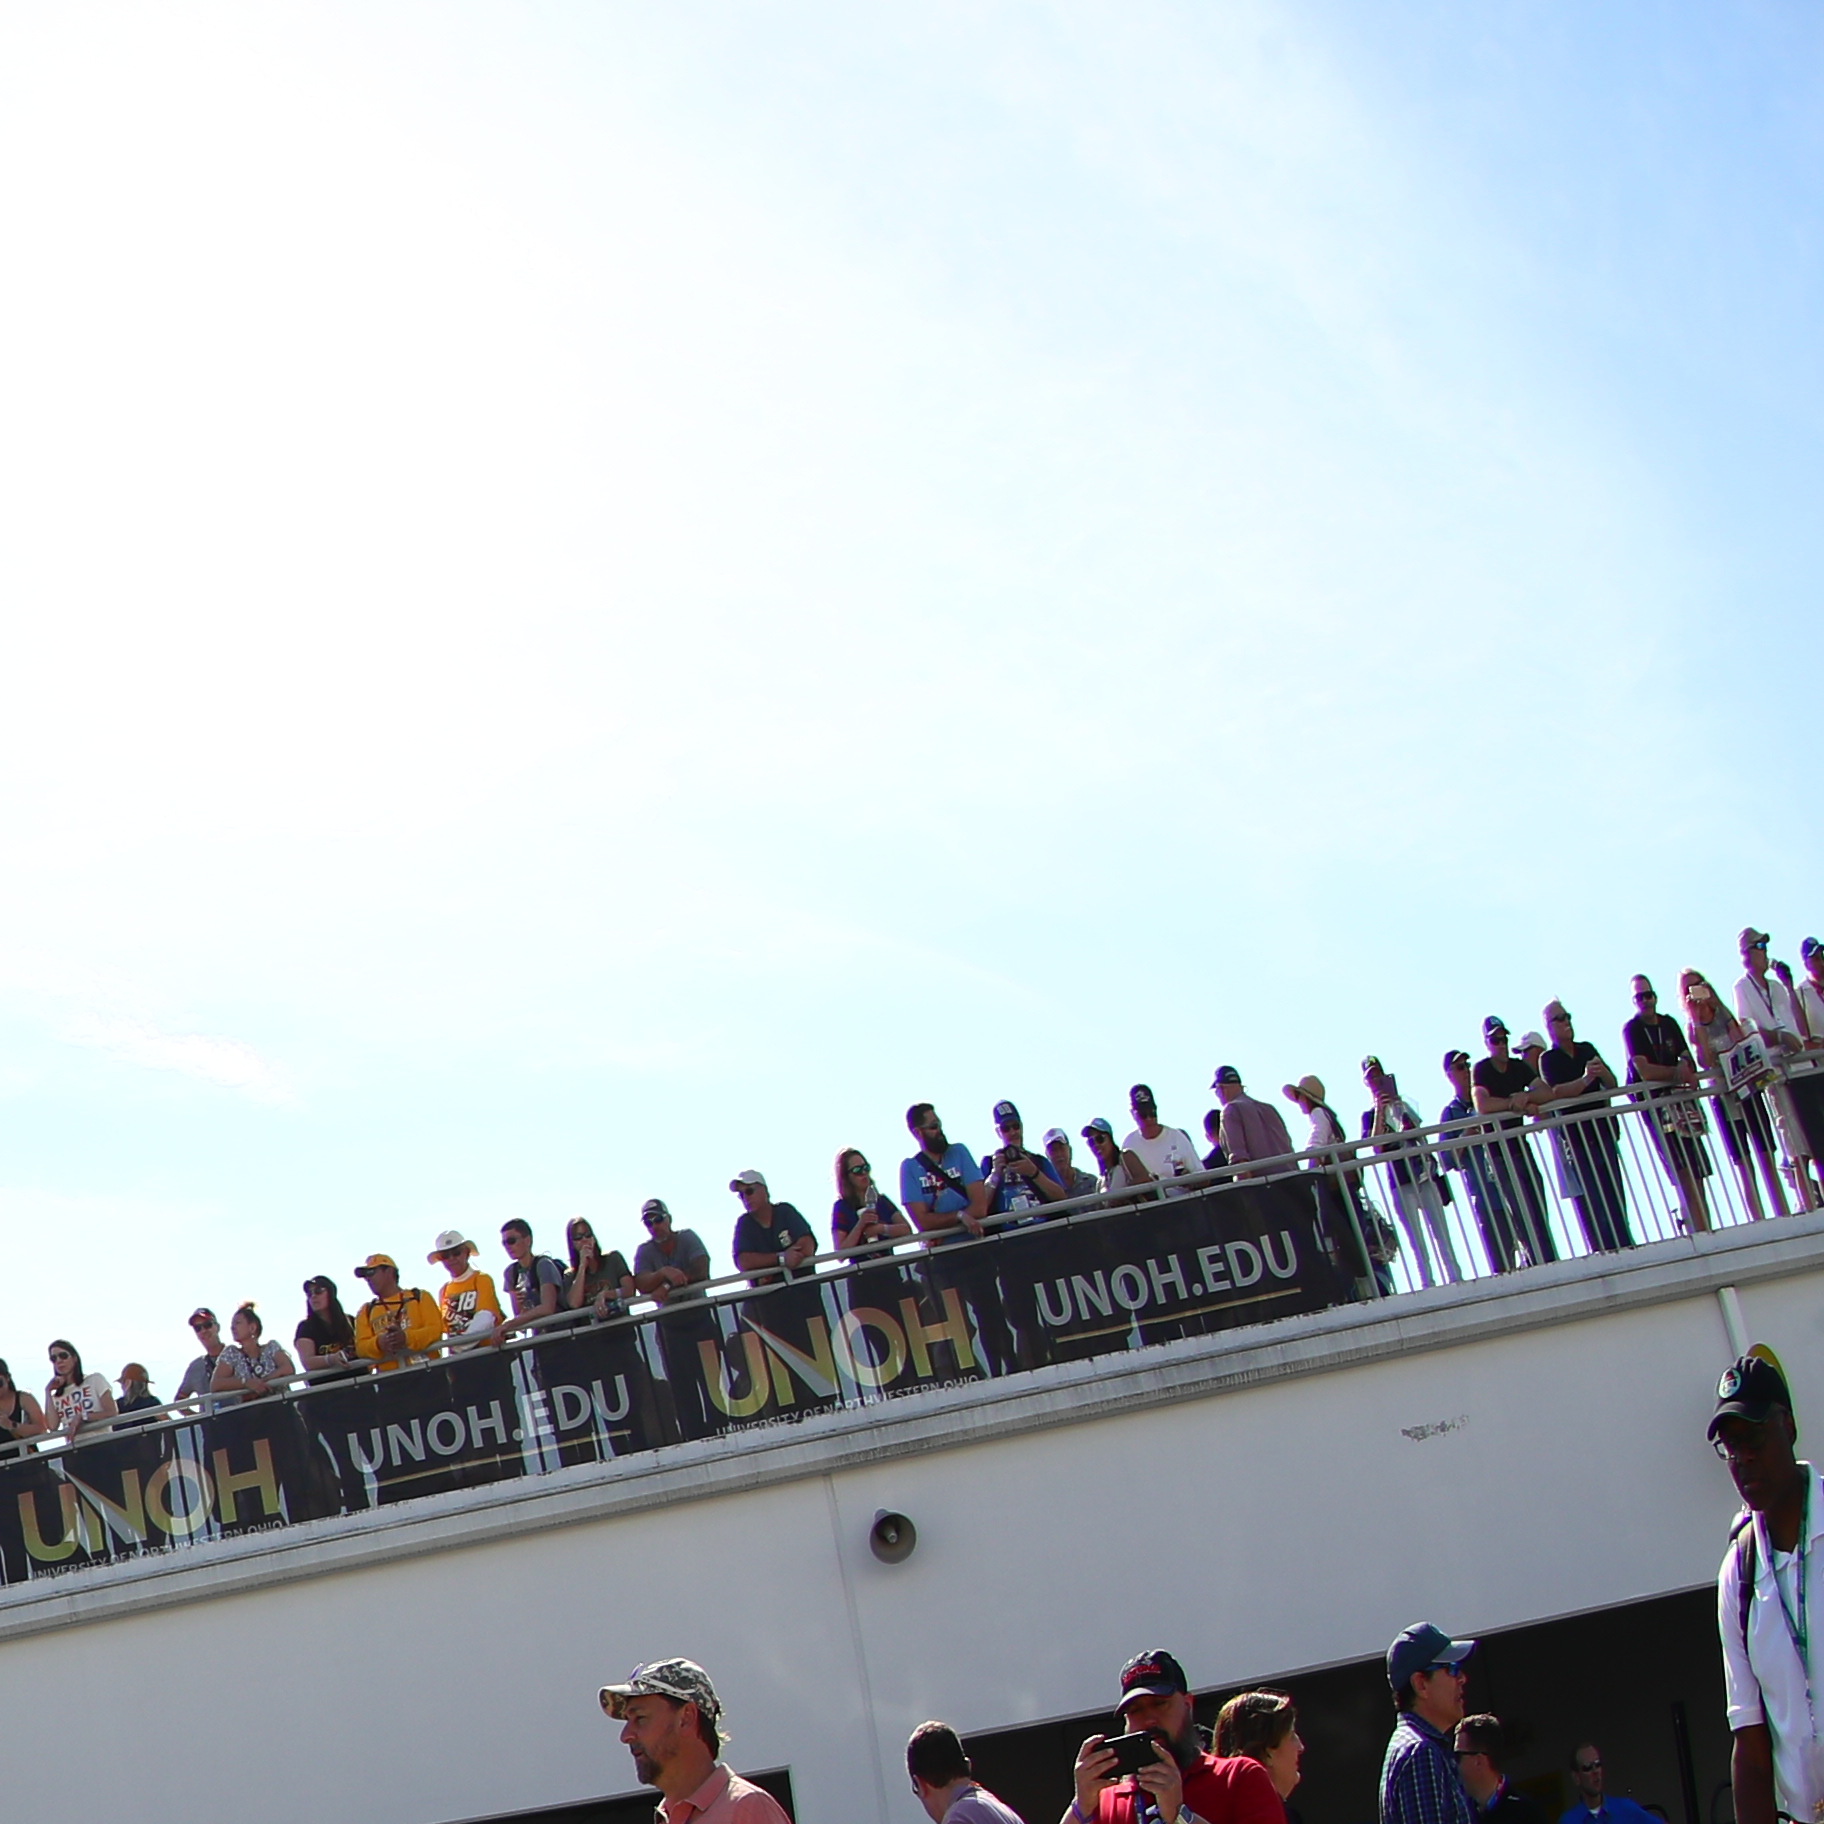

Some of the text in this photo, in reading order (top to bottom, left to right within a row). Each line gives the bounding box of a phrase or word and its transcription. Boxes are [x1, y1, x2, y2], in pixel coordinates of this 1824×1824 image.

[1034, 1230, 1298, 1326] UNOH.EDU
[697, 1287, 976, 1417] UNOH
[347, 1374, 631, 1474] UNOH.EDU
[18, 1439, 281, 1561] UNOH
